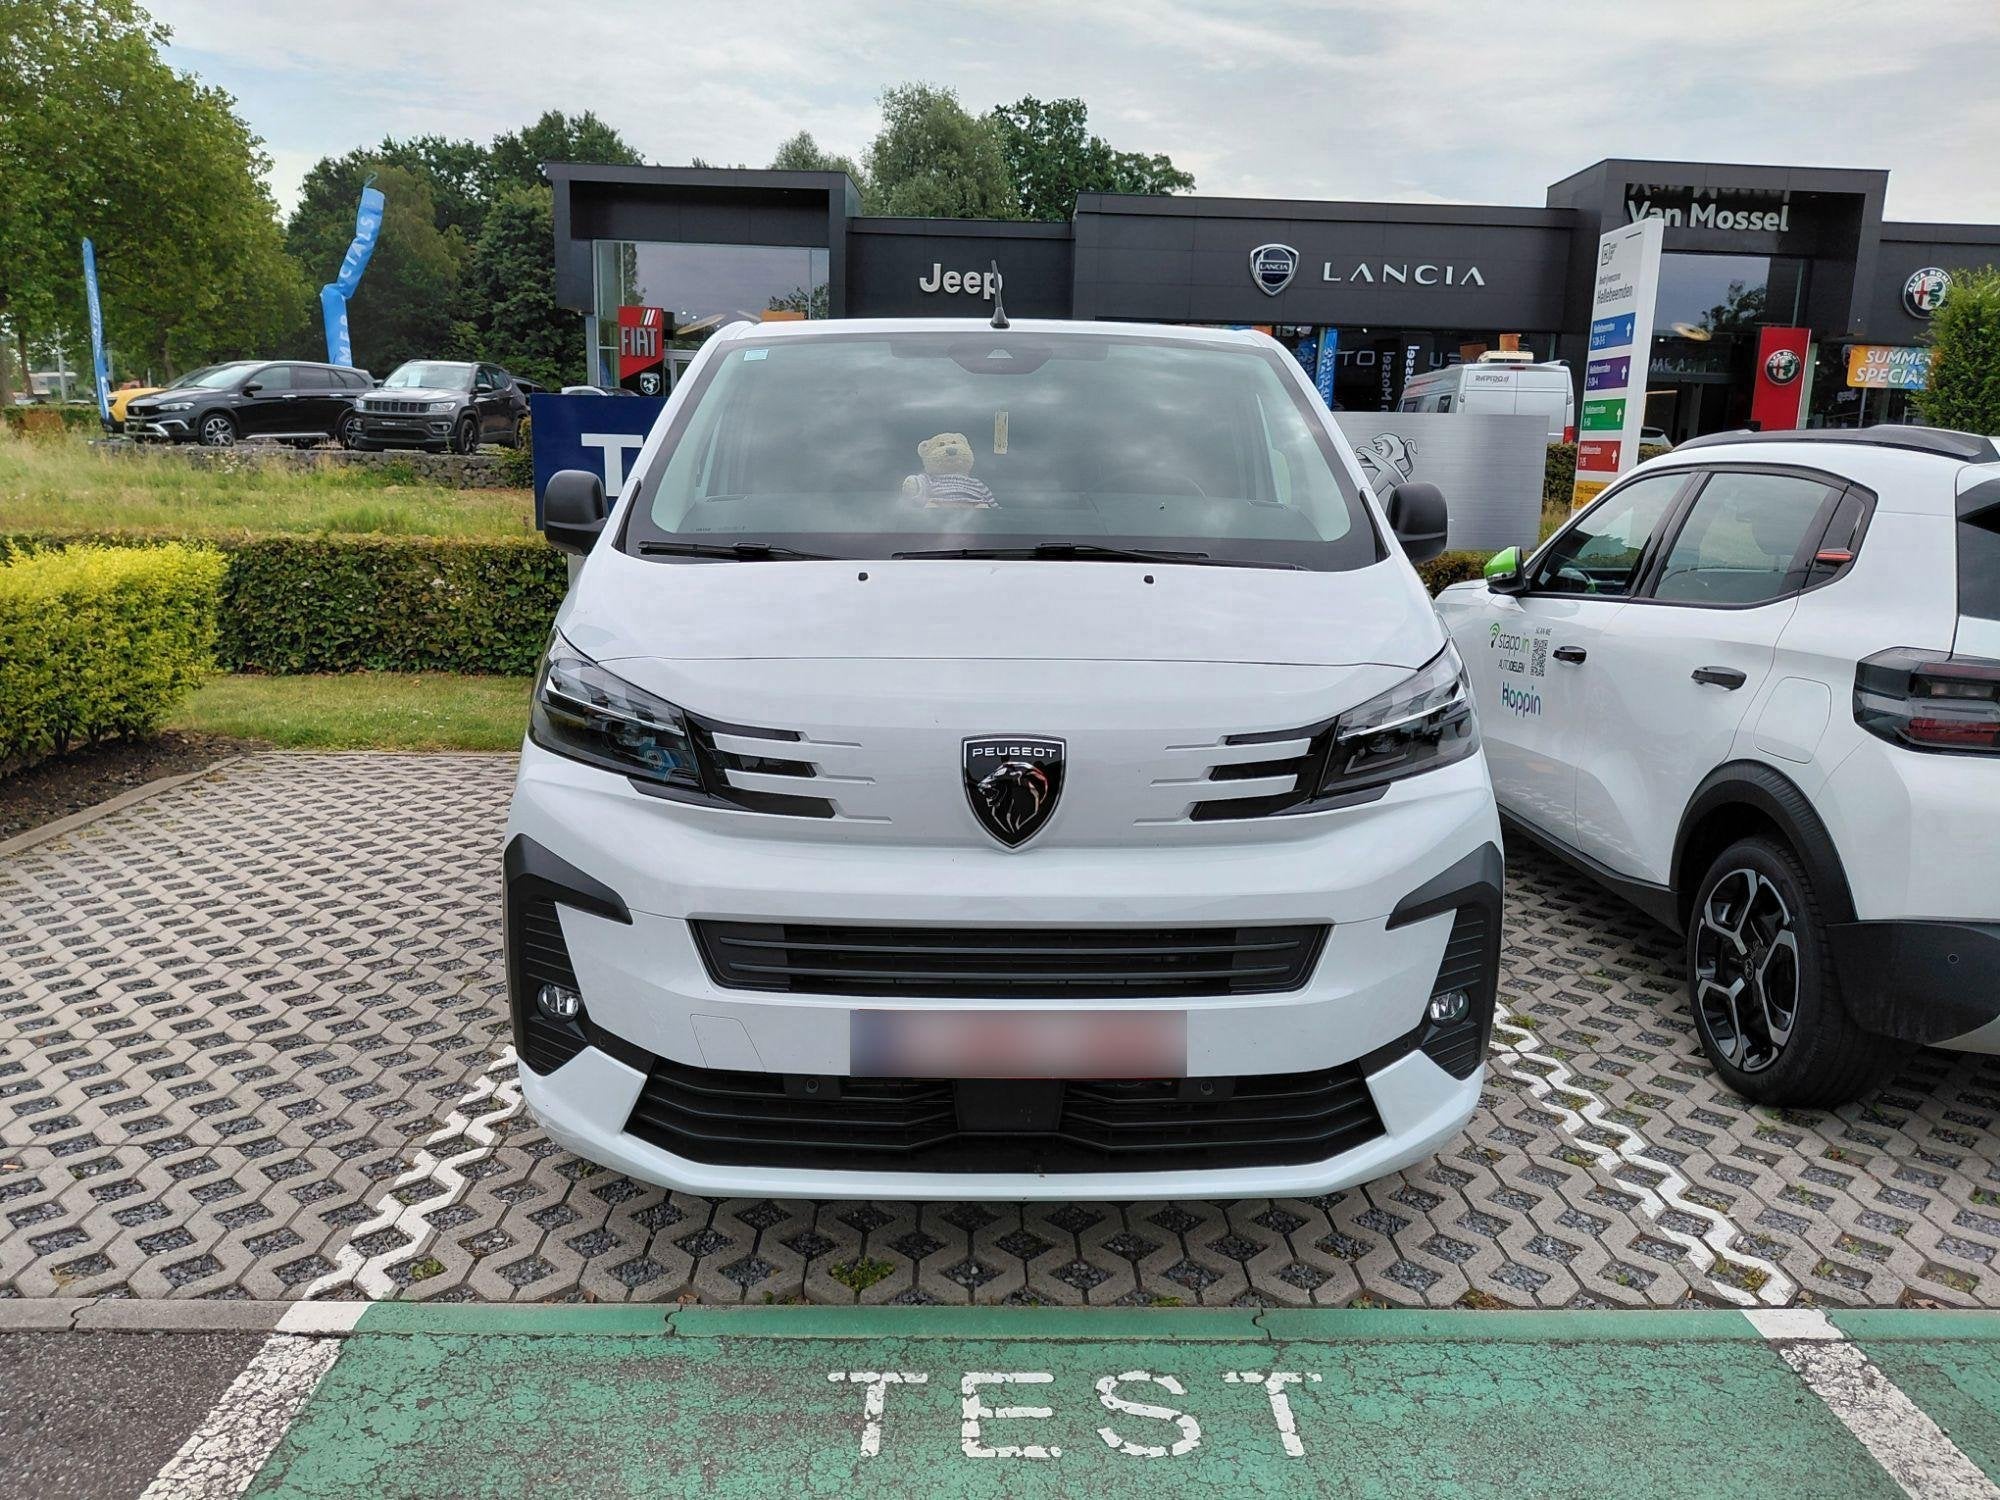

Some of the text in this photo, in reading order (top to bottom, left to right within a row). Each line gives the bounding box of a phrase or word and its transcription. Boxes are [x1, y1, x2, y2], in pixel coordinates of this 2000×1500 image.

[1690, 203, 1789, 232] Mossel
[919, 263, 1003, 300] Jeep
[1323, 262, 1486, 286] LANCIA
[1908, 272, 1926, 293] ALFA
[621, 327, 657, 357] FIAT
[1502, 681, 1541, 718] Hoppin
[972, 746, 1056, 758] PEUGEOT
[828, 1371, 1322, 1458] TEST
